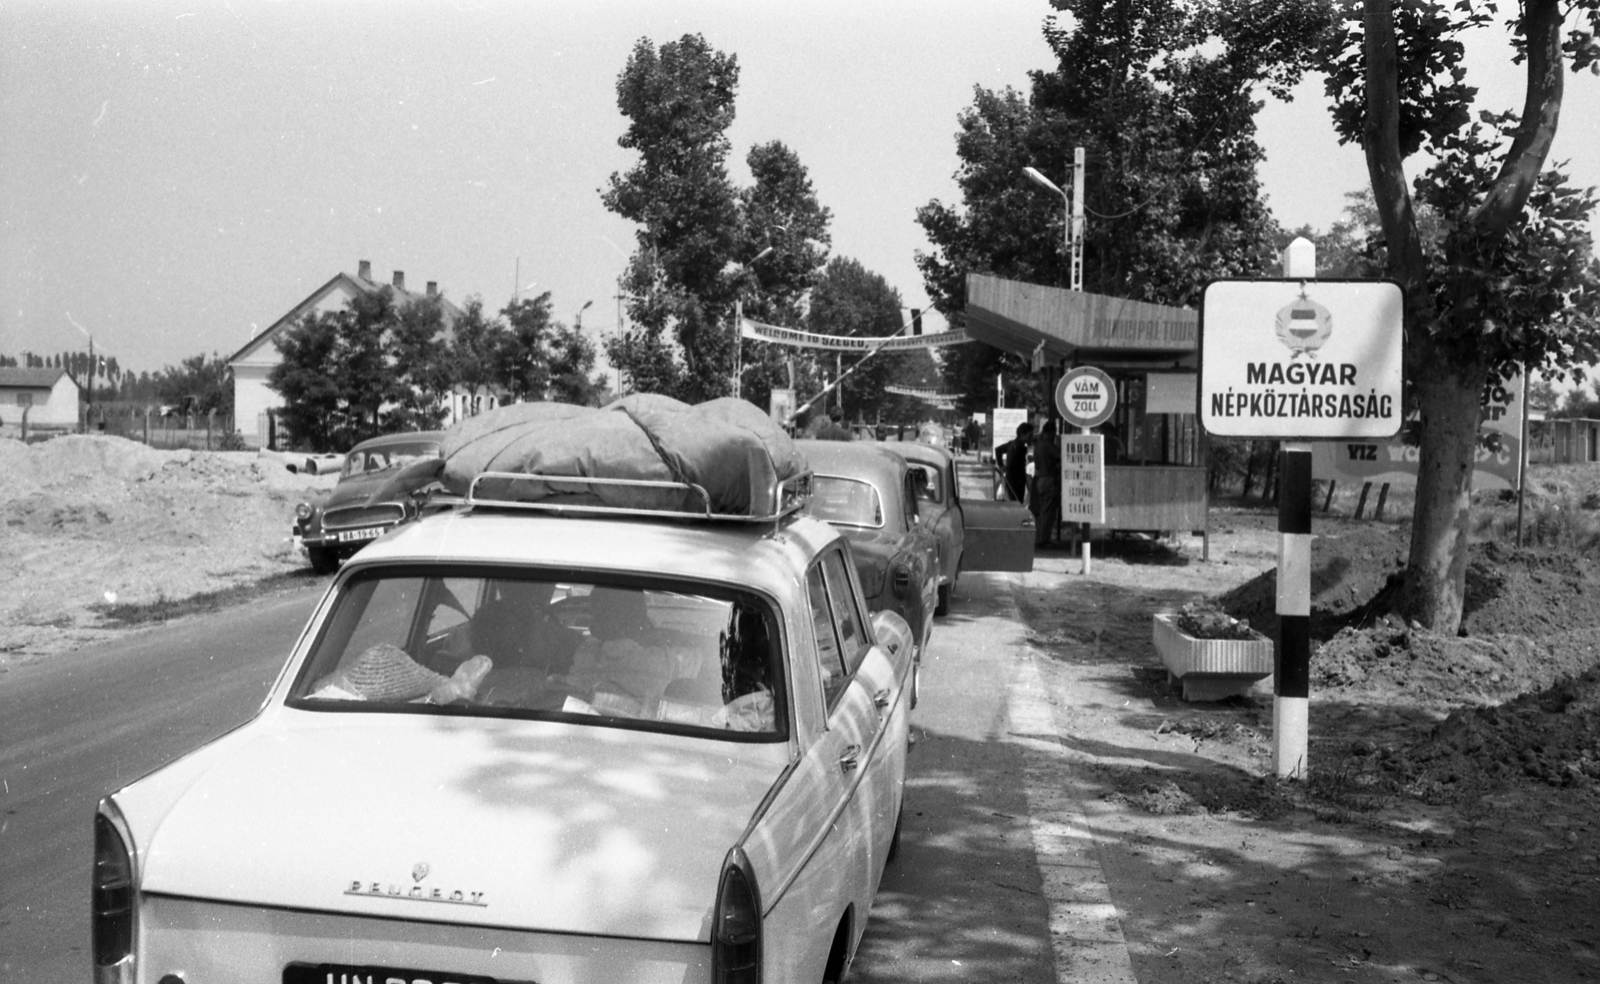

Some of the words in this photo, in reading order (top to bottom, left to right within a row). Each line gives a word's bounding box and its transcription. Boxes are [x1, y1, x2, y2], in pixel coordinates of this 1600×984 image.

[754, 326, 804, 341] WELCOME
[807, 335, 820, 343] TO
[1246, 362, 1357, 386] MAGYAR
[1074, 379, 1099, 393] VÁM
[1074, 401, 1099, 412] ZOLL
[1211, 387, 1393, 419] NÉPKÖZTÁRSASÁG
[350, 881, 484, 903] PEUGEOT
